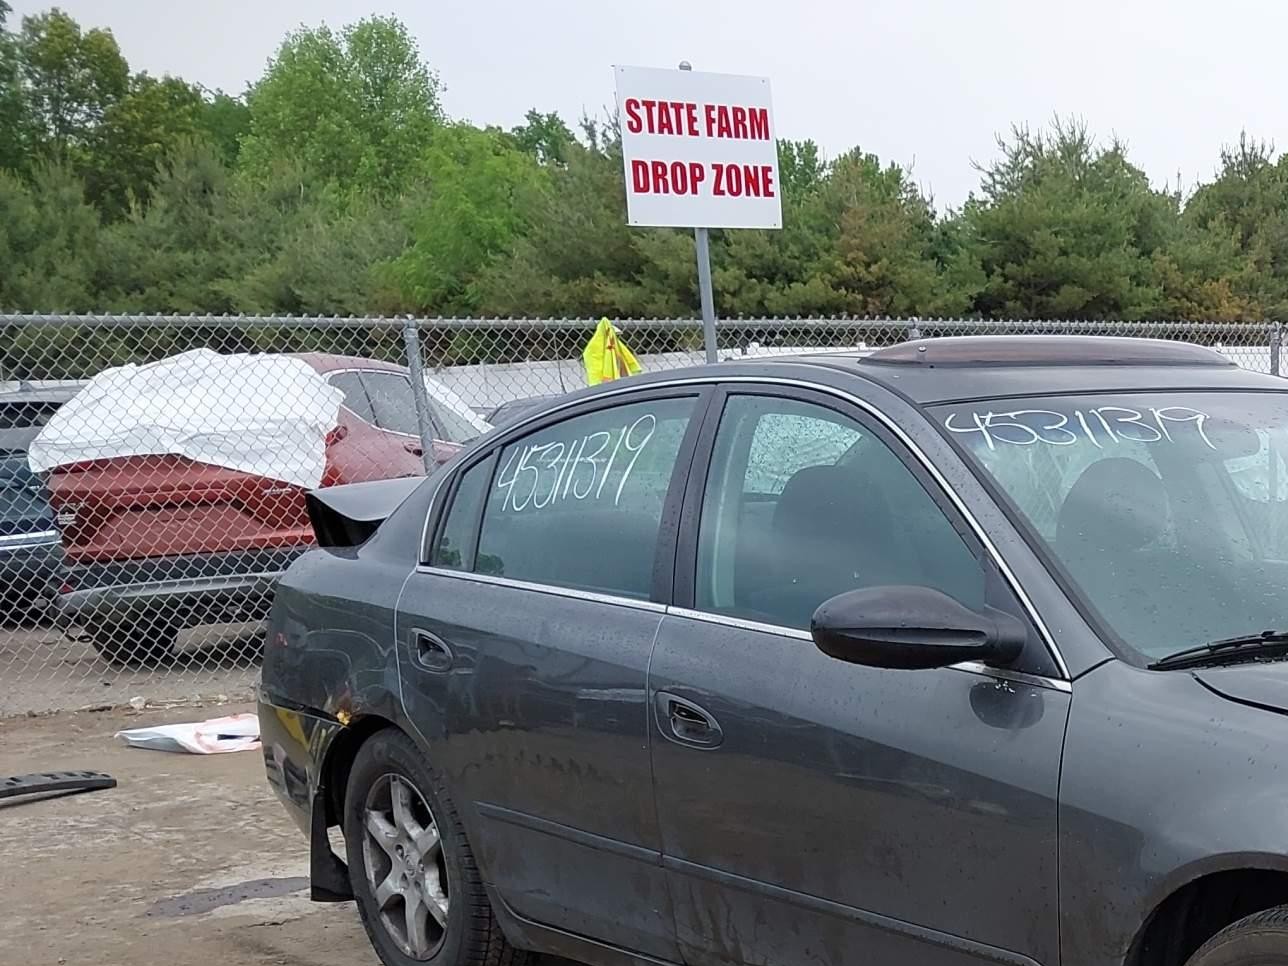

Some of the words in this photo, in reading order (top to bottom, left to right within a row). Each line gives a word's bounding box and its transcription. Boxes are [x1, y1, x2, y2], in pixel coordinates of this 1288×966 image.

[625, 98, 700, 137] STATE
[704, 104, 770, 141] FARM
[631, 159, 705, 196] DROP
[711, 163, 775, 198] ZONE
[944, 406, 1217, 451] 45311319
[497, 414, 657, 512] 45311319
